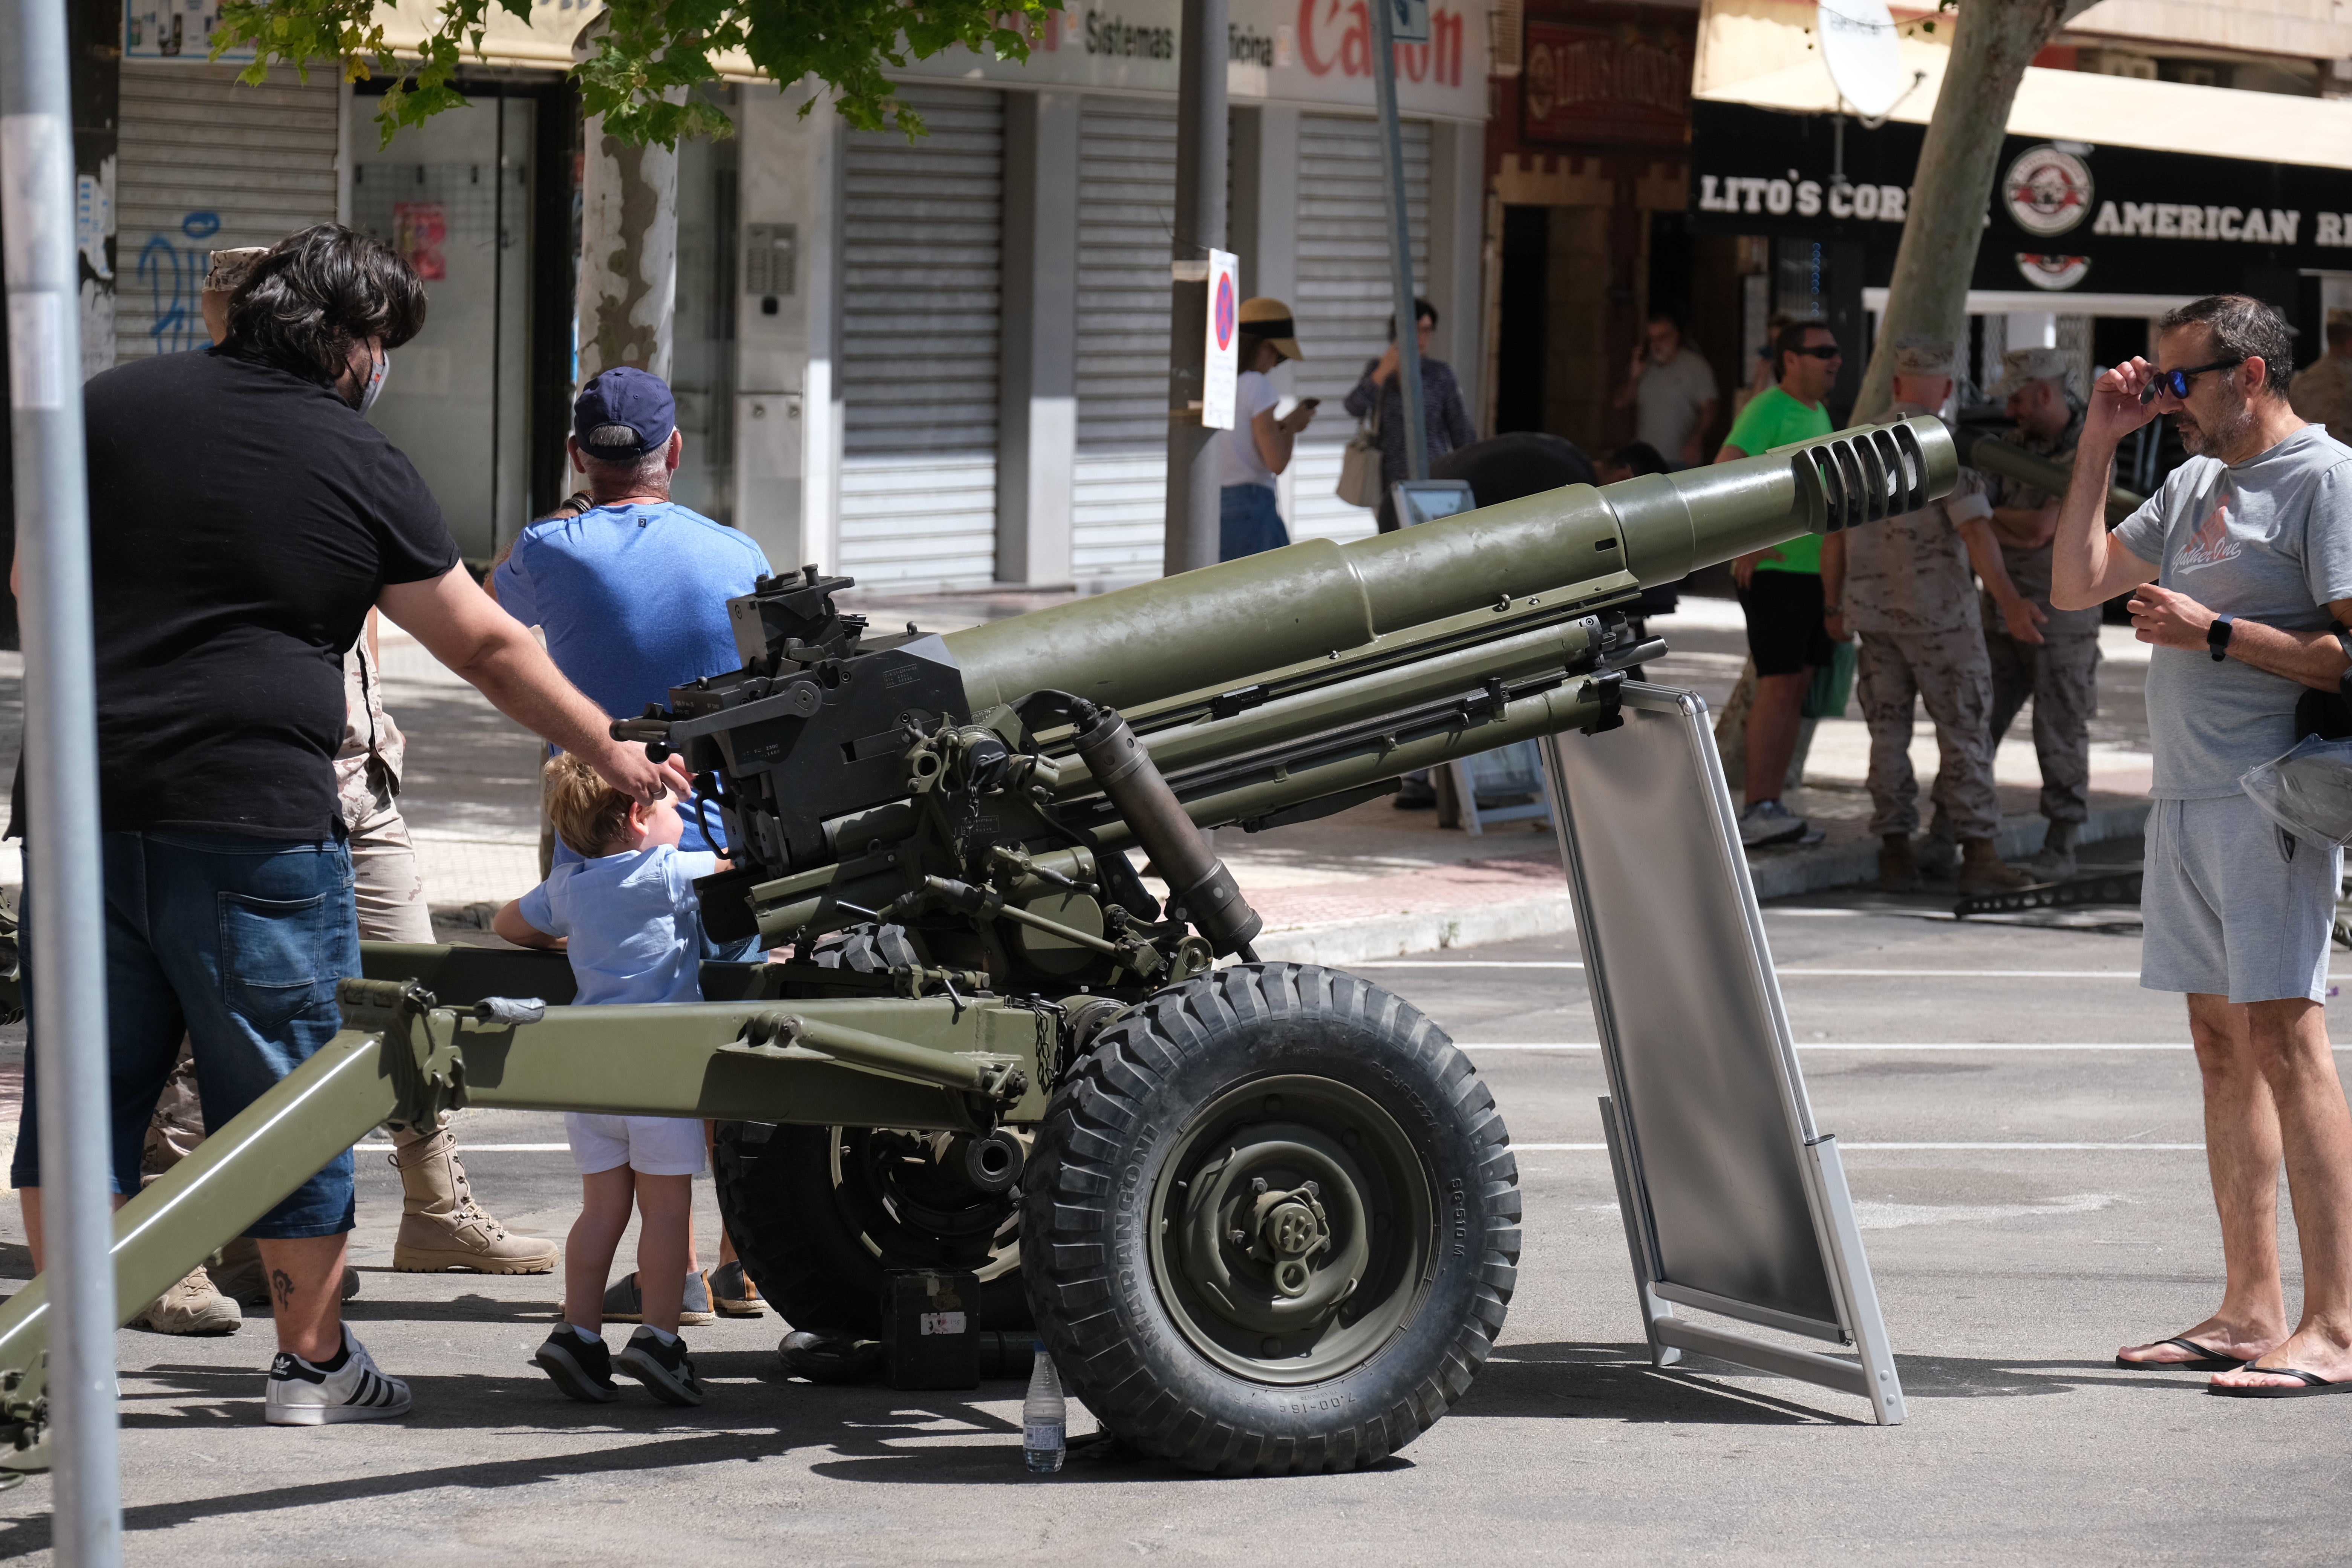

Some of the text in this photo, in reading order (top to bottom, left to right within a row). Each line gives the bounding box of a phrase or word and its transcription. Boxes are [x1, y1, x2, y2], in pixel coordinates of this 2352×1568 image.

[1086, 9, 1174, 59] Sistemas
[1227, 22, 1273, 67] ficina
[2093, 200, 2300, 245] AMERICAN
[1116, 1124, 1160, 1348] MARANGONI
[1454, 1245, 1465, 1256] M
[1292, 1392, 1356, 1413] 7.00-16
[1300, 1389, 1338, 1400] TRASPORTO
